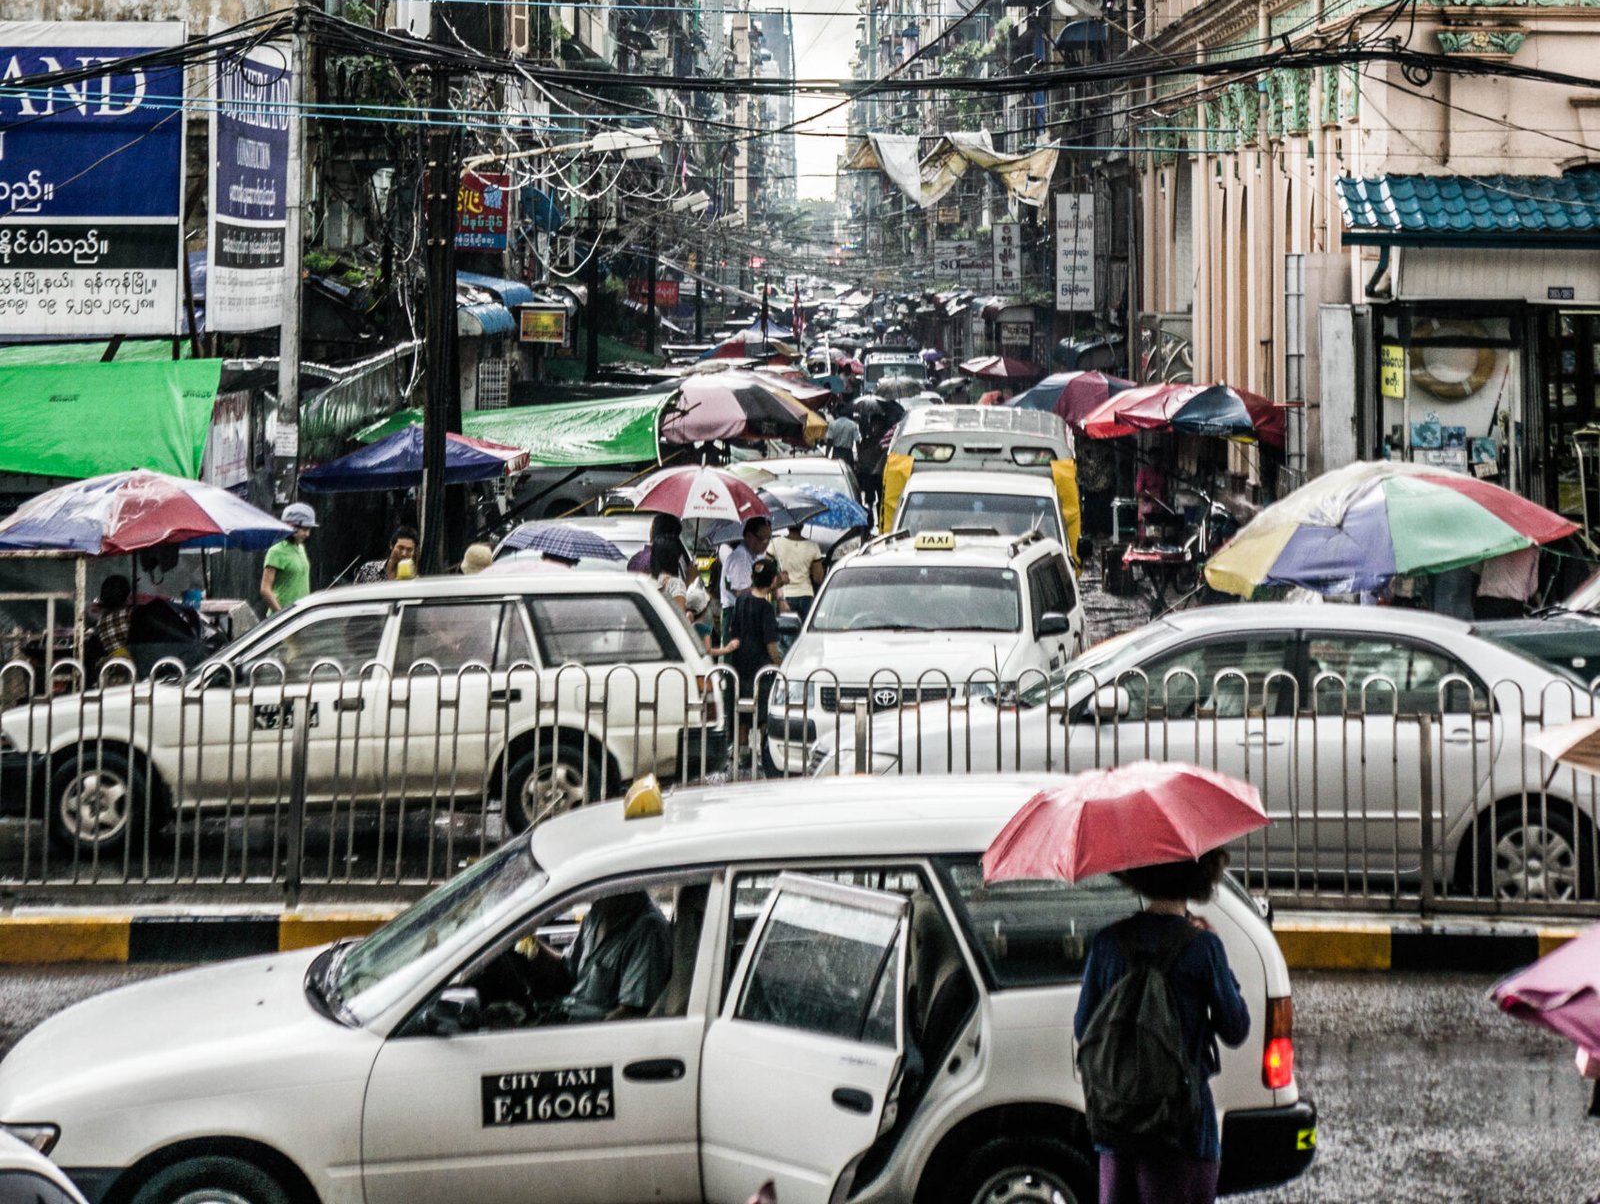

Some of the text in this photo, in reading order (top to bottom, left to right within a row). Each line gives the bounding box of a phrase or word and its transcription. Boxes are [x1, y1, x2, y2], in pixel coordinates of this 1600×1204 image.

[921, 536, 949, 544] TAXI
[498, 1068, 597, 1091] CITY TAXI
[493, 1089, 611, 1124] E-16065
